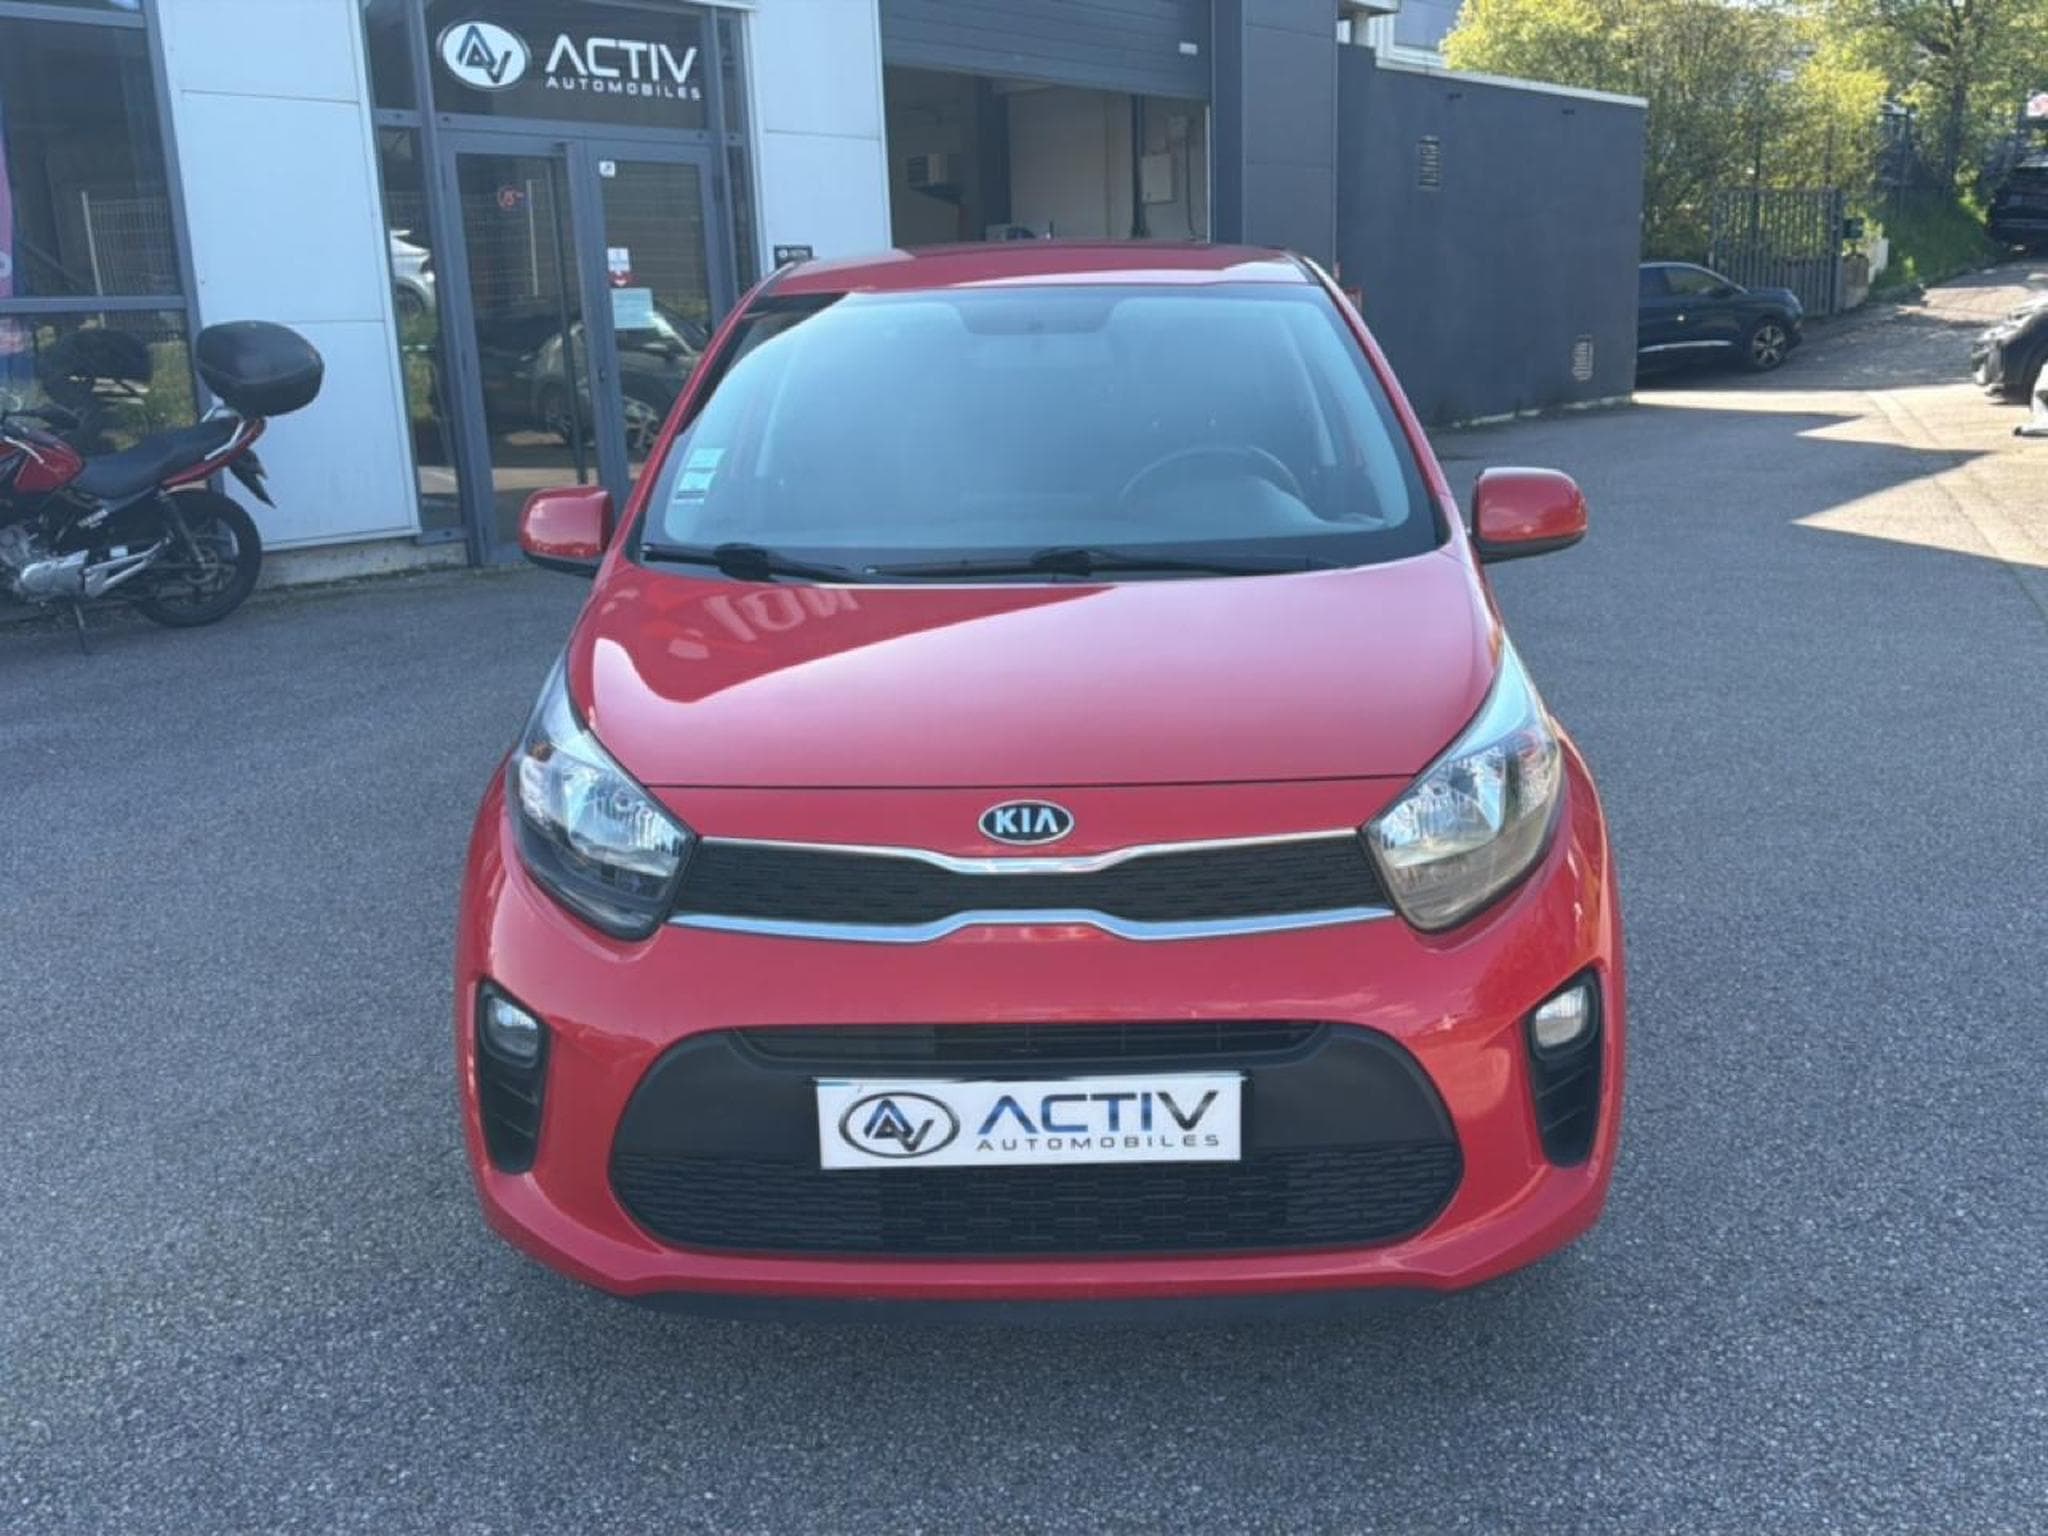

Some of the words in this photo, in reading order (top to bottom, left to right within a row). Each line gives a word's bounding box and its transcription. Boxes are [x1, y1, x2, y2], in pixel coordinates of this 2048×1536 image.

[545, 33, 698, 83] ACTIV
[545, 75, 702, 101] AUTOMOBILES
[995, 806, 1058, 833] KIA
[977, 1089, 1220, 1135] ACTIV
[976, 1134, 1220, 1152] AUTOMOBILES
